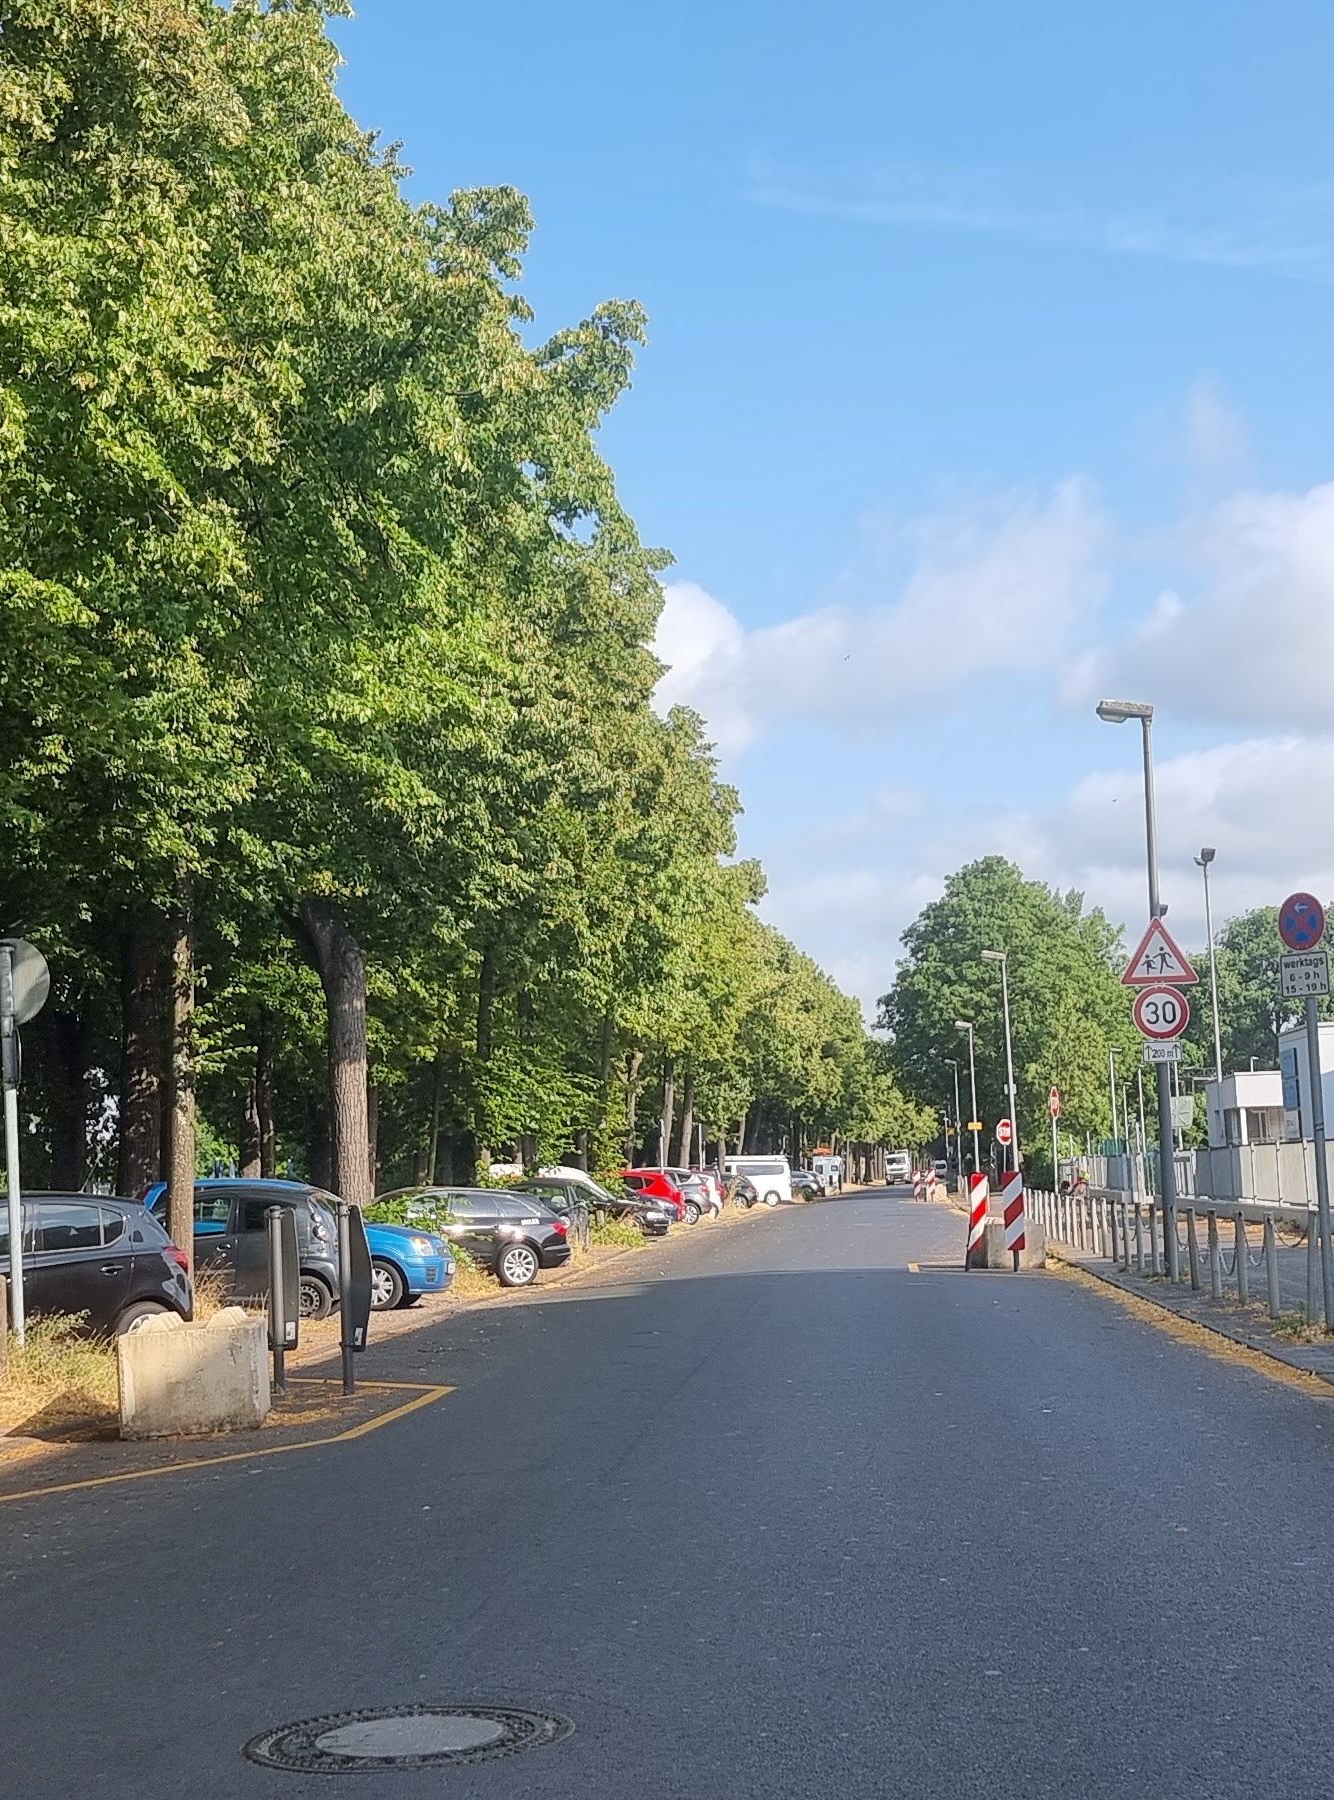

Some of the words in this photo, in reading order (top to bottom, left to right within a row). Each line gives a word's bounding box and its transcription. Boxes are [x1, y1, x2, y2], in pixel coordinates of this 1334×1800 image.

[1283, 957, 1324, 969] werktags
[1290, 973, 1296, 982] 6
[1305, 971, 1310, 980] 9
[1313, 970, 1320, 979] h
[1285, 984, 1297, 994] 15
[1306, 982, 1317, 991] 19
[1320, 982, 1326, 990] h
[1146, 1001, 1176, 1024] 30
